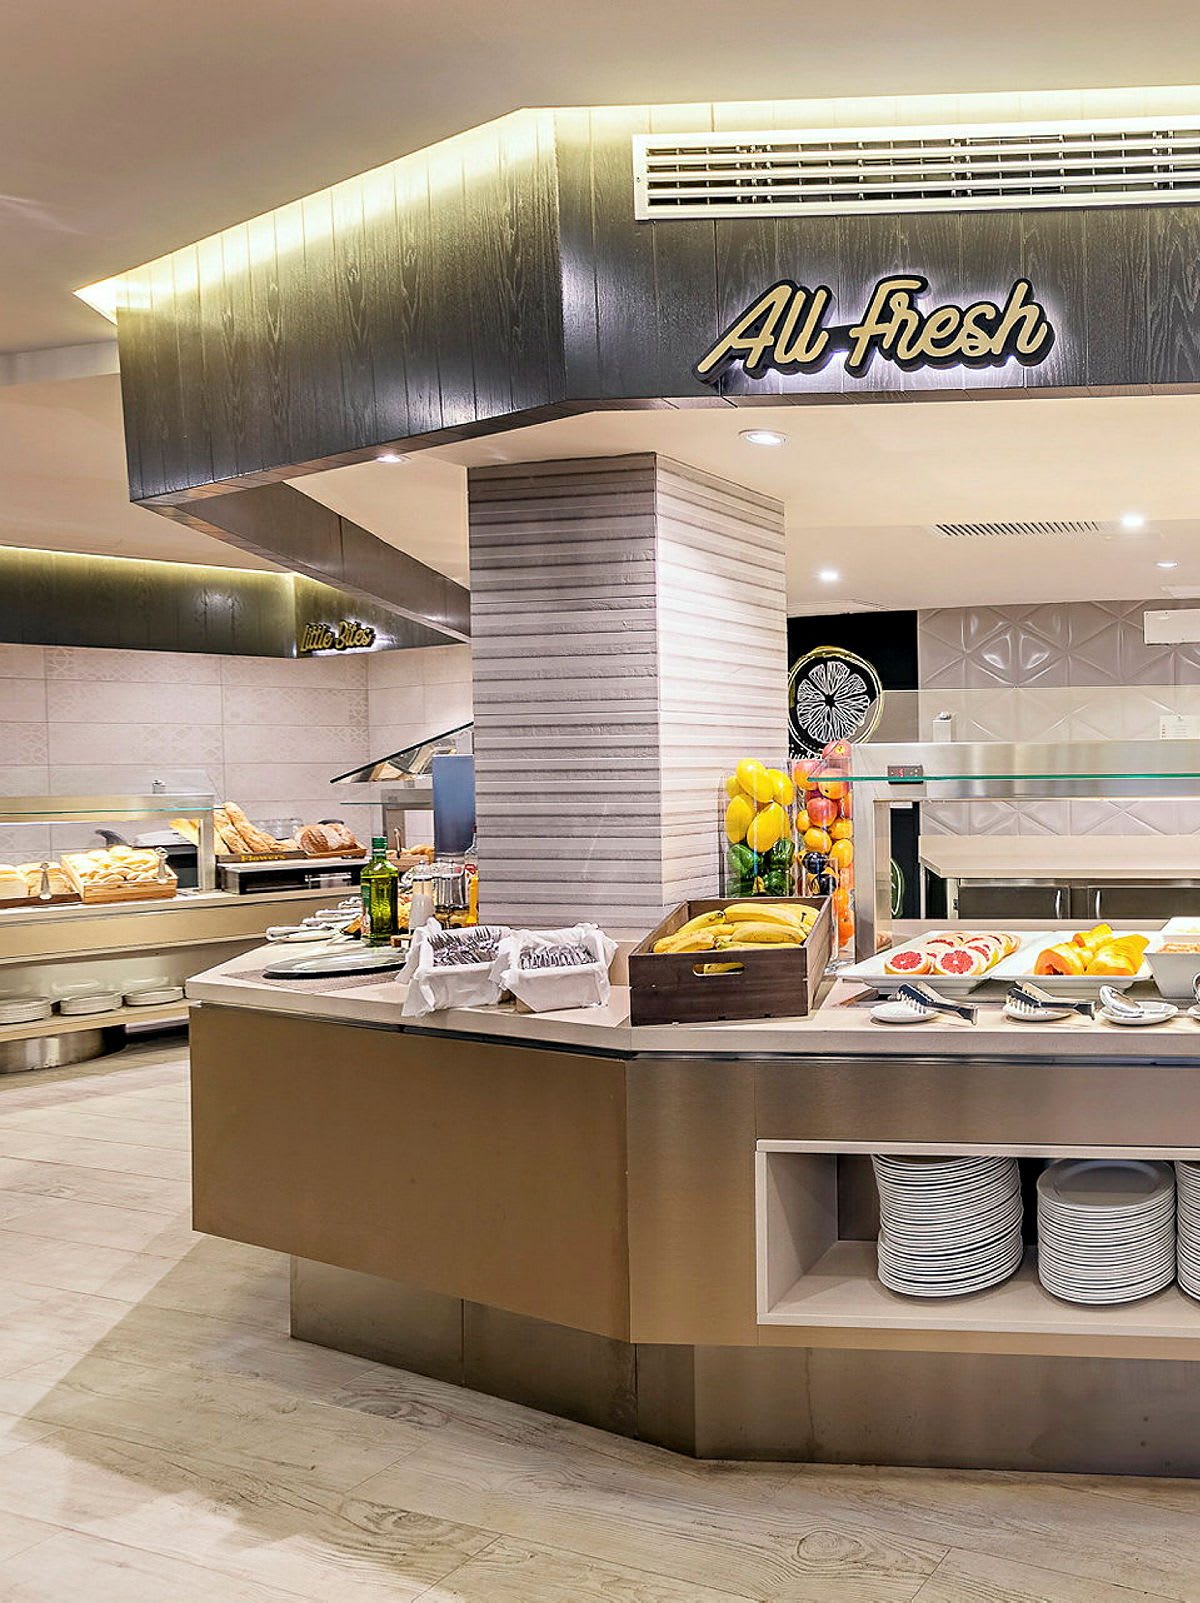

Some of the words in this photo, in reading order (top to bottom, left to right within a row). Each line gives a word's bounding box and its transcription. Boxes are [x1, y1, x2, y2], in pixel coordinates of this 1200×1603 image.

[696, 281, 831, 376] All
[847, 277, 1050, 370] Fresh
[300, 622, 333, 652] Little
[335, 620, 373, 649] Bites
